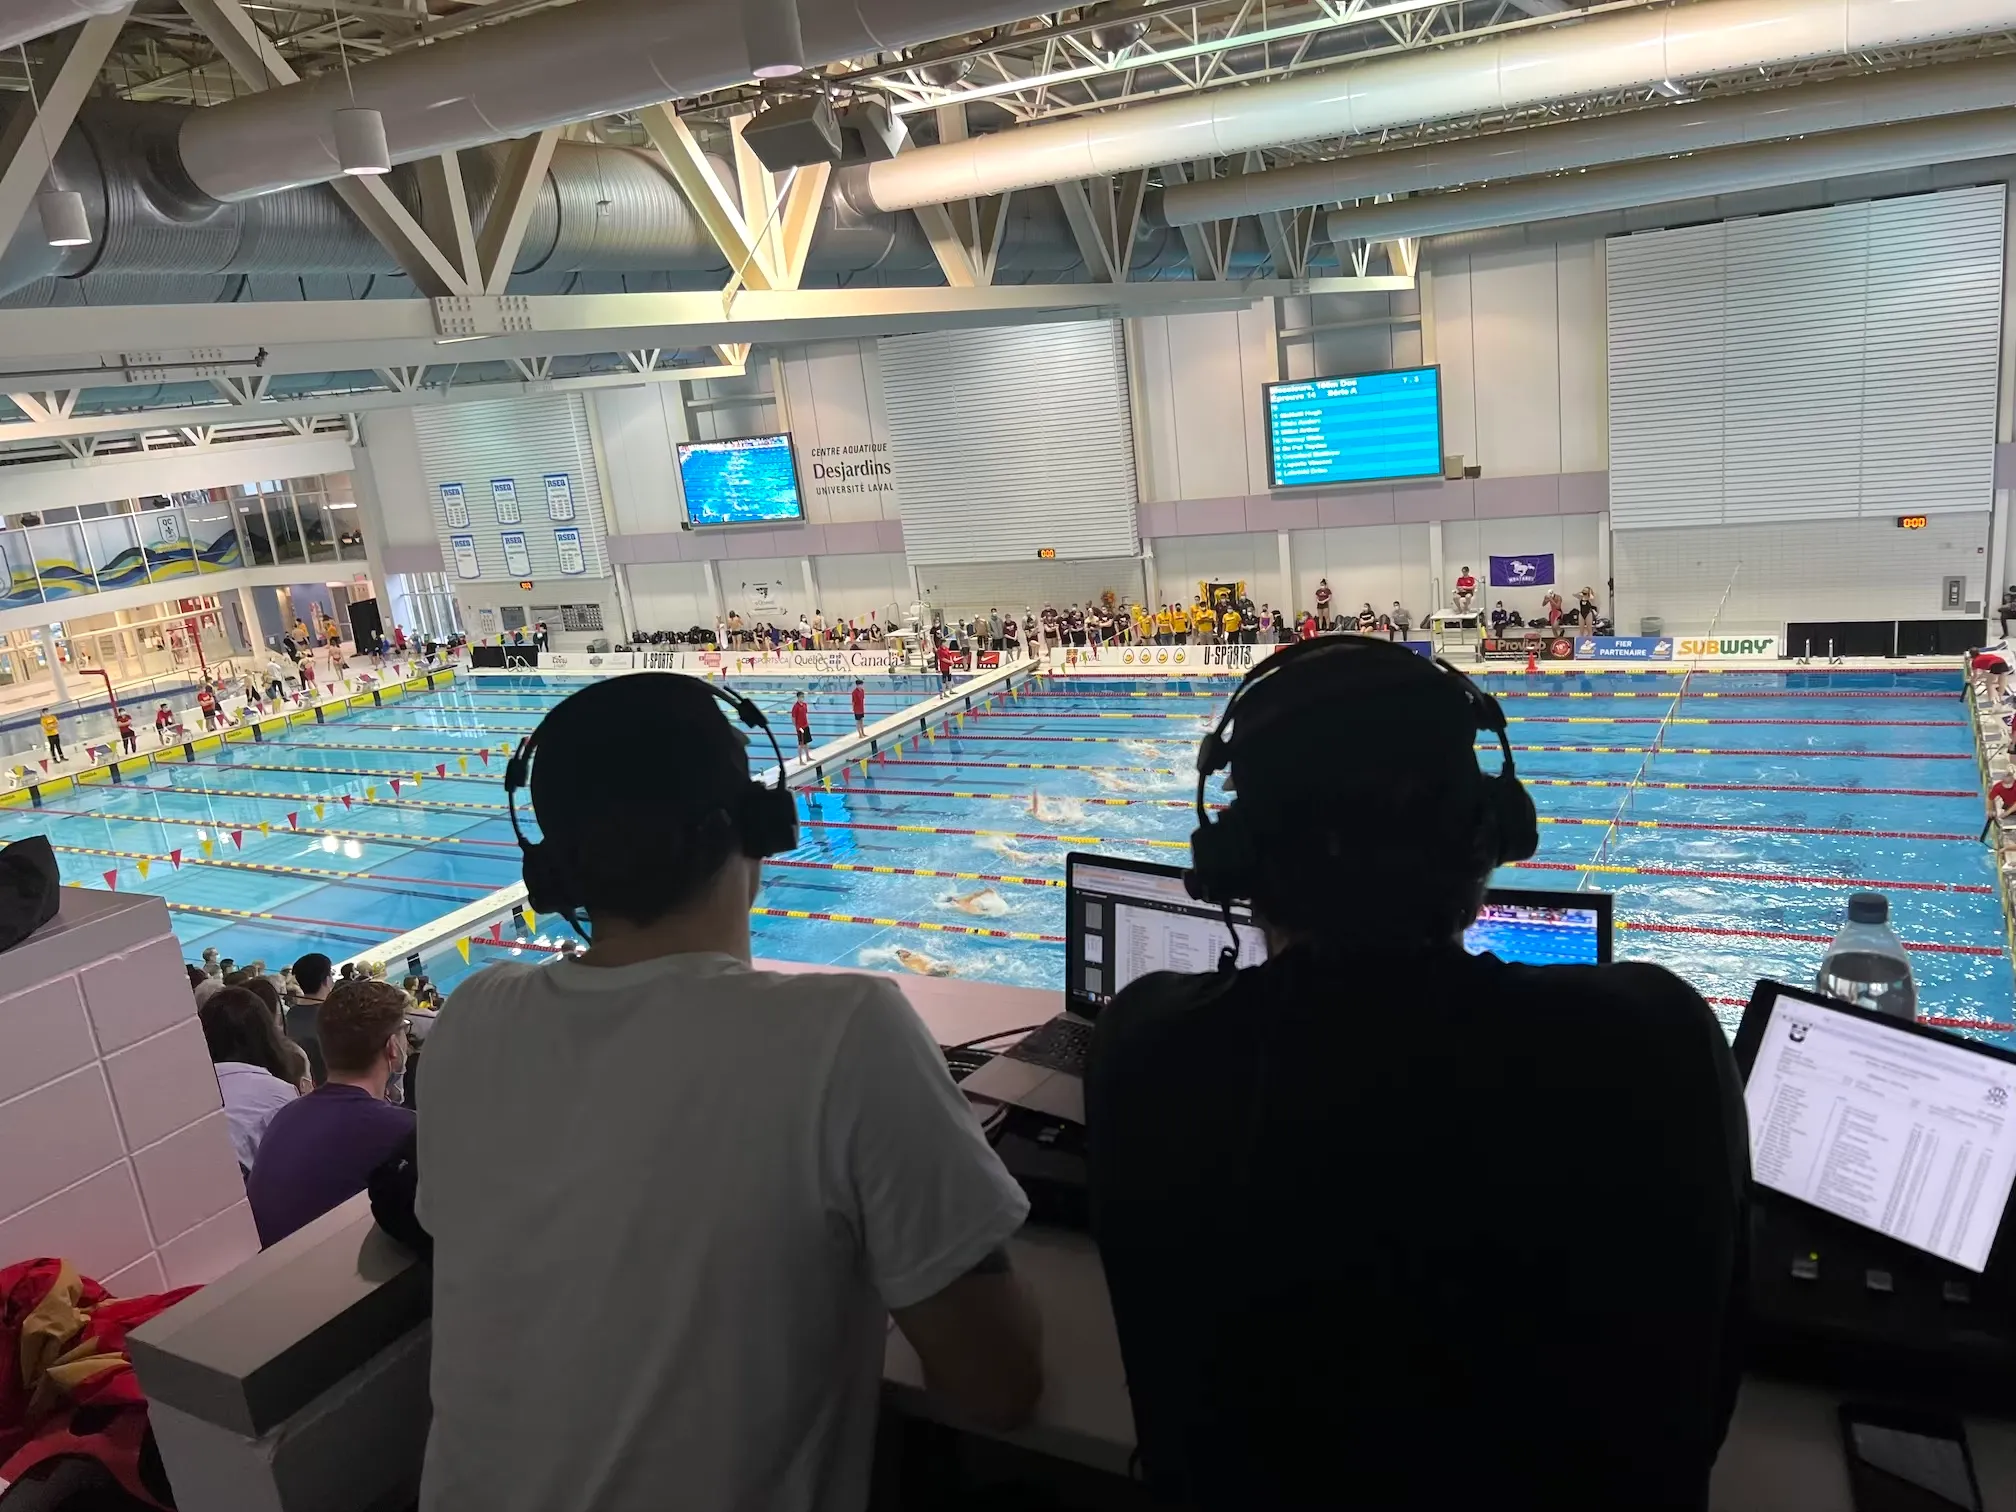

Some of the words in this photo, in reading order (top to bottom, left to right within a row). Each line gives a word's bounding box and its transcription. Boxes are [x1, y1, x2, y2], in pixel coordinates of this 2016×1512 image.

[811, 446, 841, 457] CENTRE
[842, 443, 888, 455] AQUATIQUE
[813, 460, 891, 482] Desjardins
[494, 483, 512, 492] RSEQ
[547, 479, 566, 487] RSEQ
[443, 488, 461, 497] RSEQ
[816, 483, 865, 495] UNIVERSITÉ
[868, 483, 894, 492] LAVAL
[162, 518, 173, 527] QC
[504, 536, 523, 545] RSEQ
[557, 533, 576, 541] RSEQ
[1615, 640, 1632, 648] FIER
[1677, 638, 1774, 656] SUBWAY
[1599, 648, 1647, 657] PARTENAIRE
[794, 653, 828, 666] Québec
[851, 652, 899, 667] Canada
